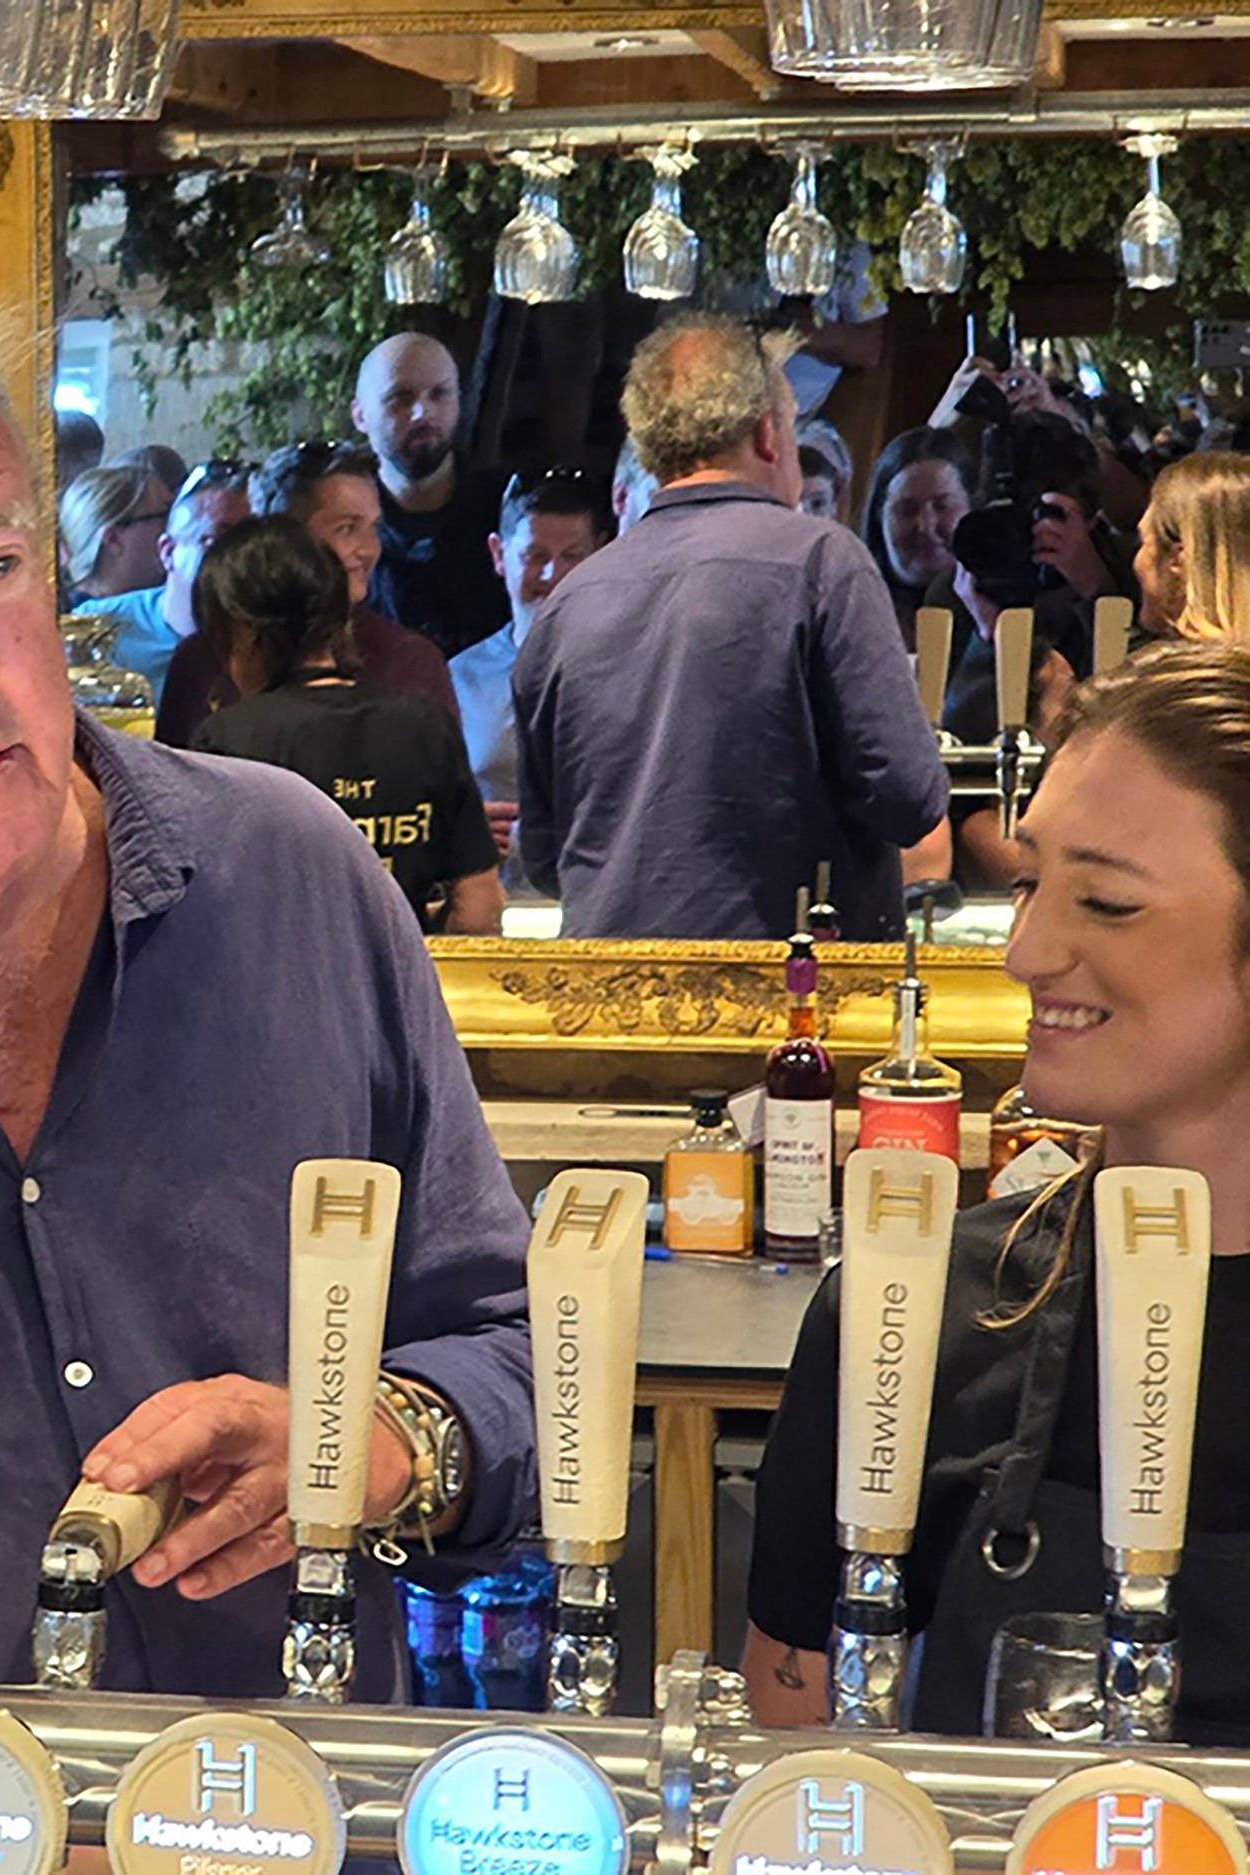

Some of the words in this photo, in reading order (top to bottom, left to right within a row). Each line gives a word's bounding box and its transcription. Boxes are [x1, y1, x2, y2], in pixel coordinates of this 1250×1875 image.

[307, 1283, 350, 1490] Hawkstone
[552, 1294, 580, 1506] Hawkstone
[859, 1281, 908, 1494] Hawkstone
[1130, 1302, 1172, 1515] Hawkstone
[132, 1812, 315, 1858] Hawkstone
[430, 1817, 591, 1852] Hawkstone
